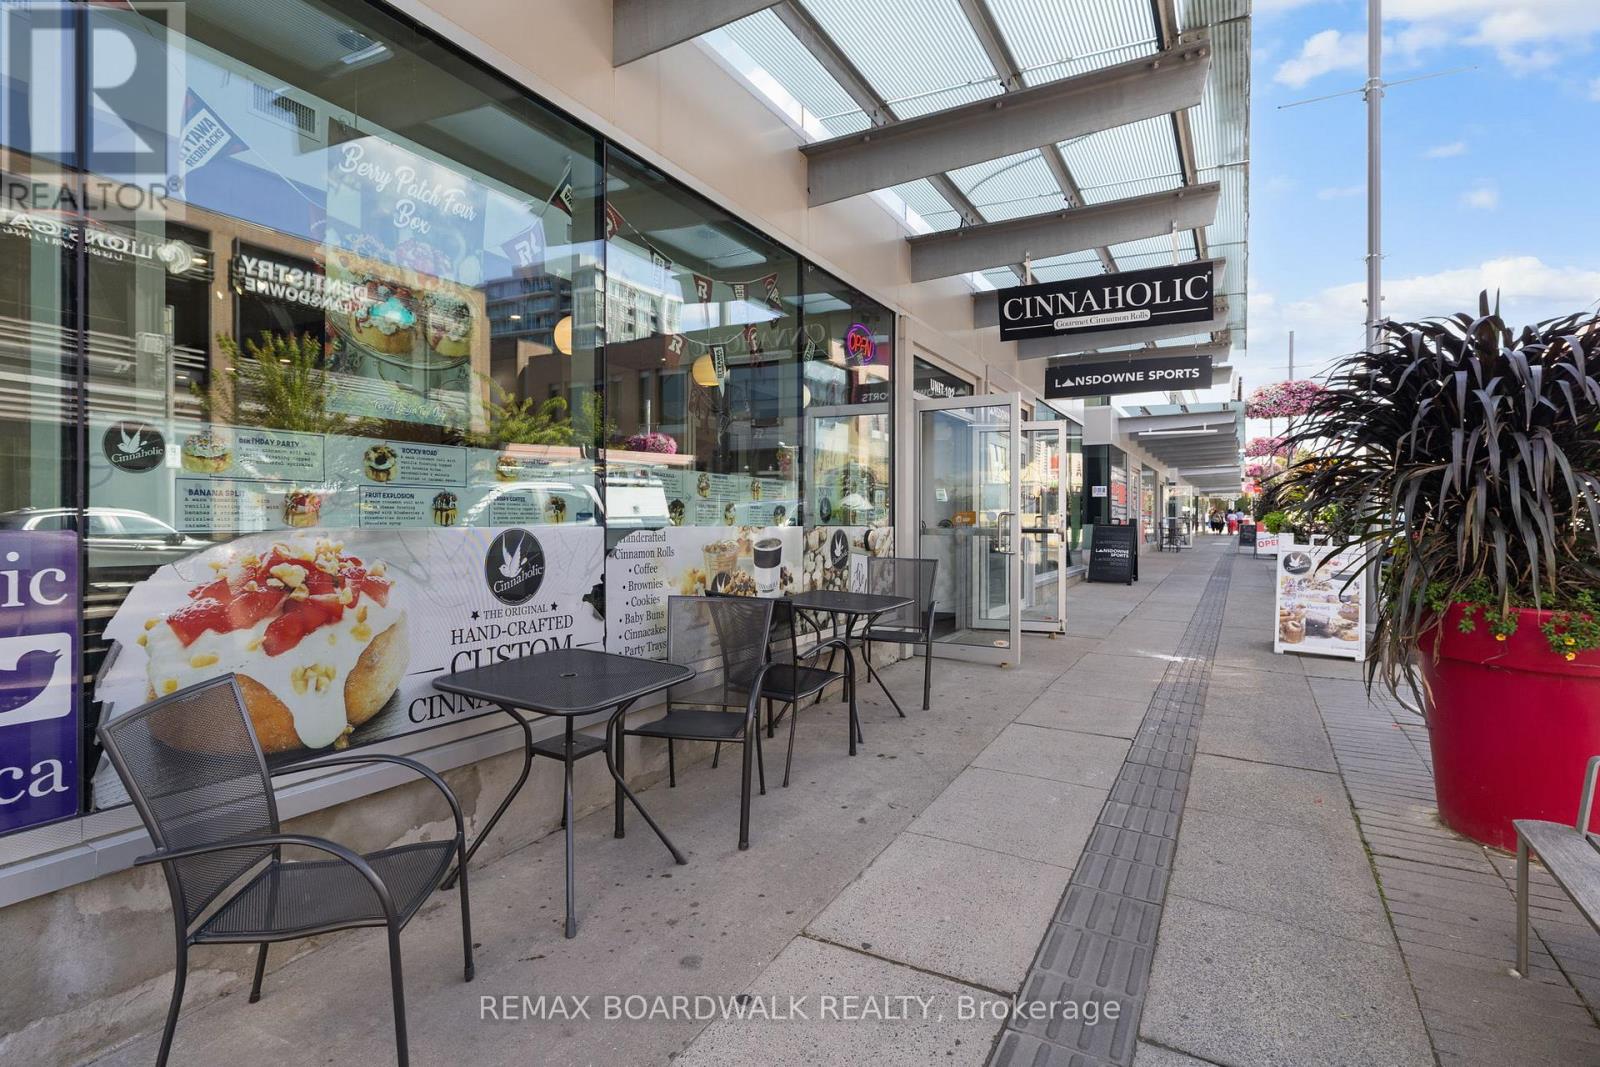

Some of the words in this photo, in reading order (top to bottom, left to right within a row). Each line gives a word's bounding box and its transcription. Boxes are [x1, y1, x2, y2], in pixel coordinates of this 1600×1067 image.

[338, 142, 392, 192] Berry
[394, 166, 441, 206] Patch
[393, 199, 432, 235] Box
[1003, 275, 1209, 320] CINNAHOLIC
[1056, 319, 1089, 328] Gourmet
[1089, 315, 1129, 325] Cinnamon
[1130, 312, 1149, 320] Rolls
[849, 333, 872, 357] OPEN
[1055, 371, 1144, 388] LANSDOWNE
[1148, 368, 1200, 381] SPORTS
[276, 440, 300, 448] PARTY
[401, 447, 421, 455] ROCKY
[111, 446, 164, 462] Cinnaholic
[188, 488, 224, 496] BANANA
[364, 491, 382, 499] FRUIT
[614, 547, 655, 560] Cinnamon
[656, 545, 675, 558] Rolls
[633, 562, 658, 575] Coffee
[493, 564, 544, 593] Cinnaholic
[628, 578, 663, 592] Brownies
[630, 594, 661, 608] Cookies
[483, 610, 503, 620] THE
[504, 604, 548, 617] ORIGINAL
[625, 612, 644, 625] Baby
[646, 610, 665, 621] Buns
[451, 614, 574, 645] HAND-CRAFTED
[624, 624, 667, 641] Cinnacakes
[624, 645, 645, 656] Party
[647, 640, 667, 653] Trays
